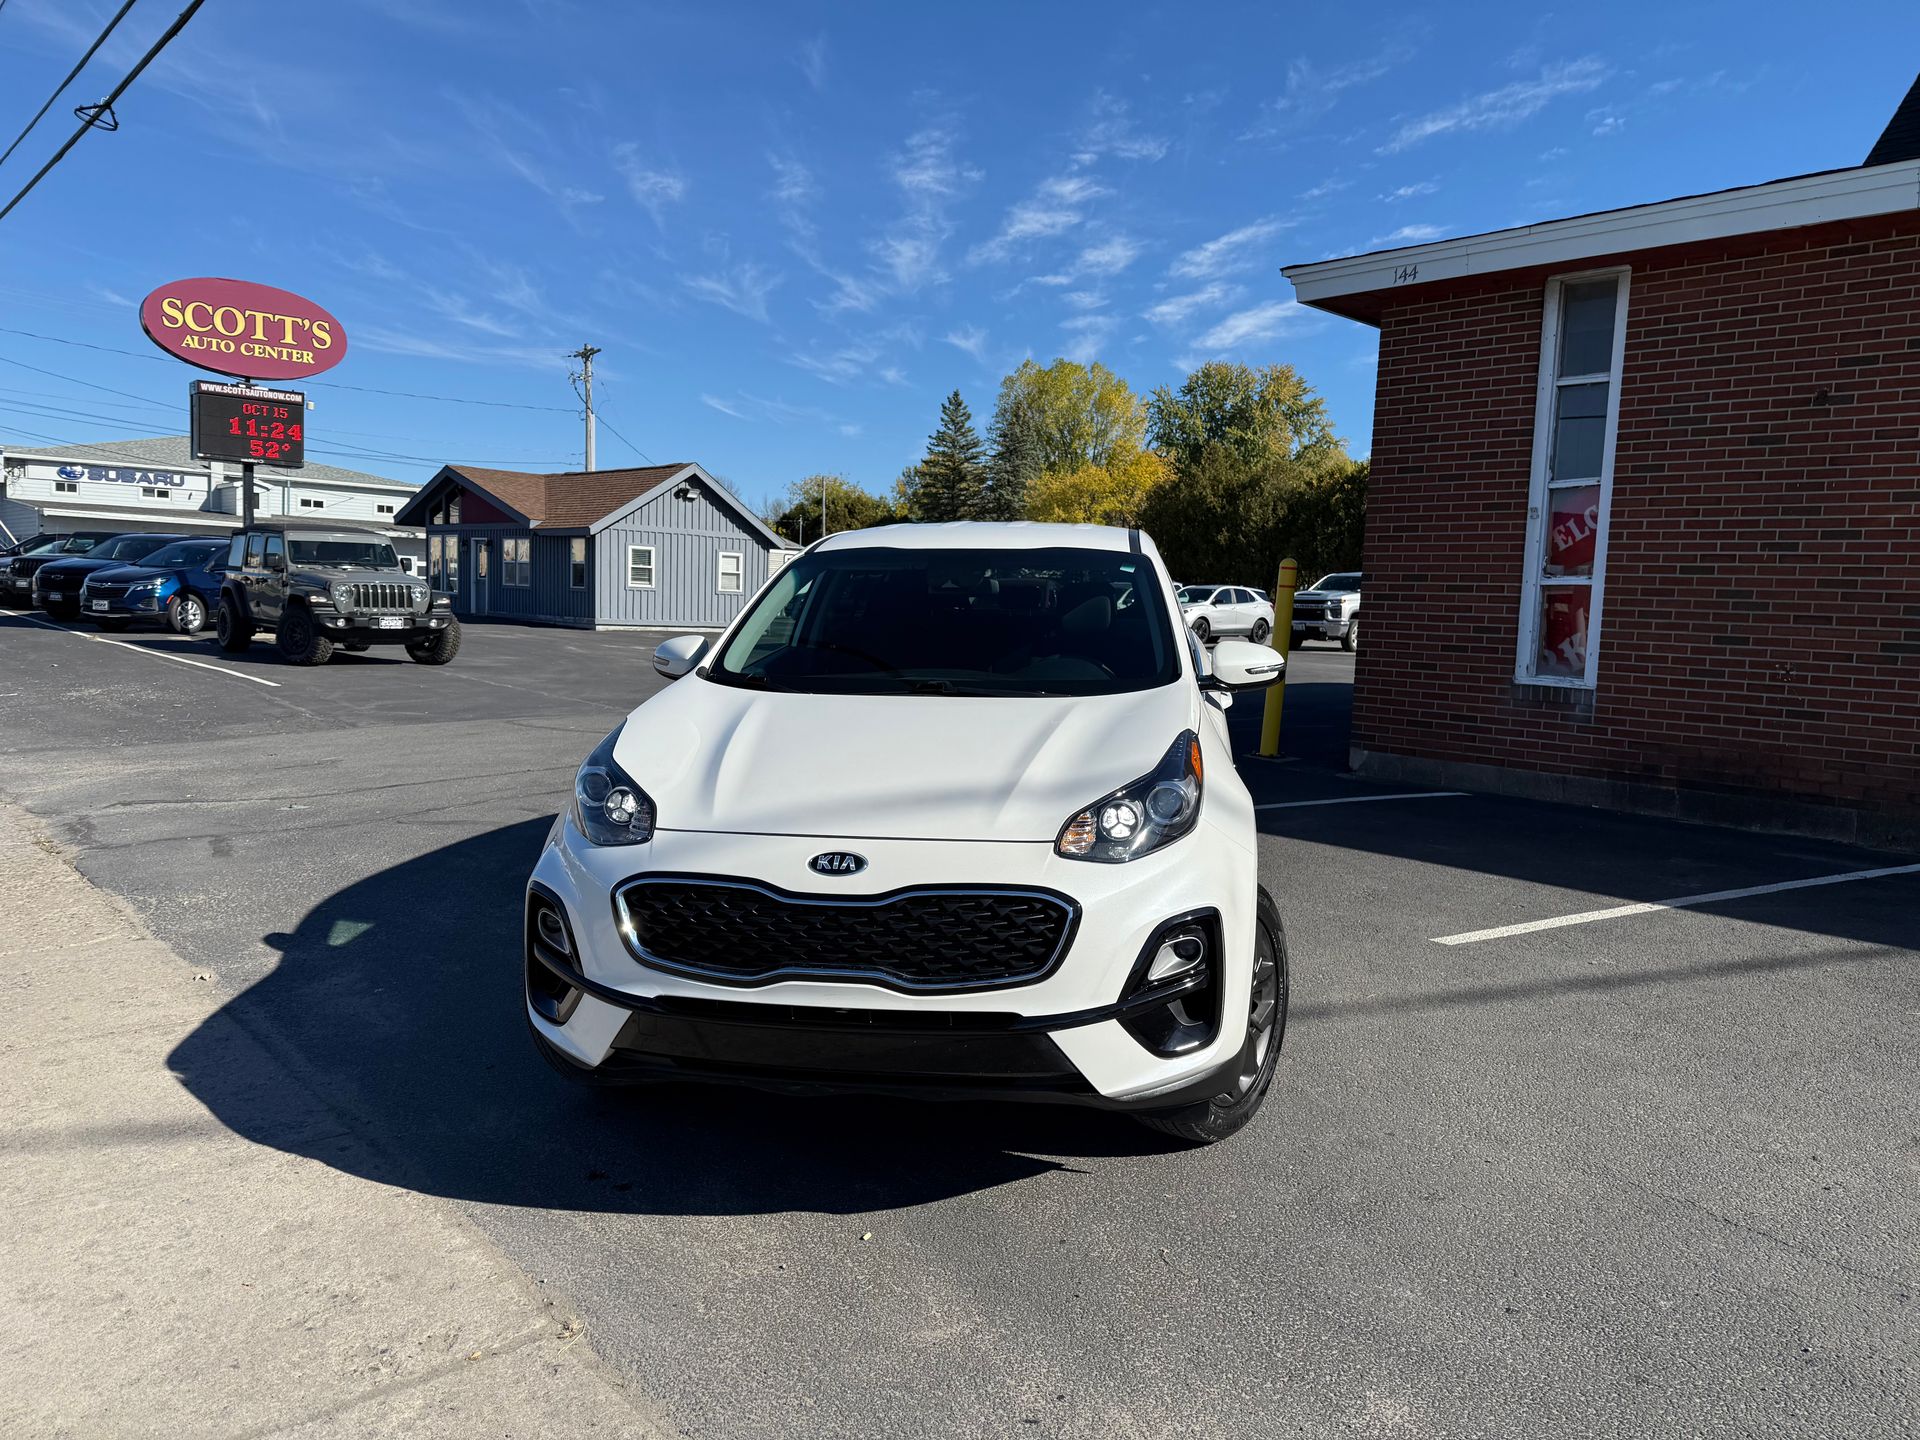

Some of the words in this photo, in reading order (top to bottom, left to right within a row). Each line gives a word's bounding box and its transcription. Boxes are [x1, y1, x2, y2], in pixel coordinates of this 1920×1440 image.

[1393, 265, 1418, 284] 144
[161, 297, 332, 349] SCOTT'S
[181, 335, 236, 353] AUTO
[240, 343, 315, 364] CENTER
[200, 383, 302, 402] WWW.SCOTTSAUTONOW.COM
[242, 403, 270, 416] OCT
[273, 407, 289, 419] 15
[229, 417, 302, 441] 11:24
[88, 467, 185, 487] SUBARU
[816, 854, 856, 871] KIA
